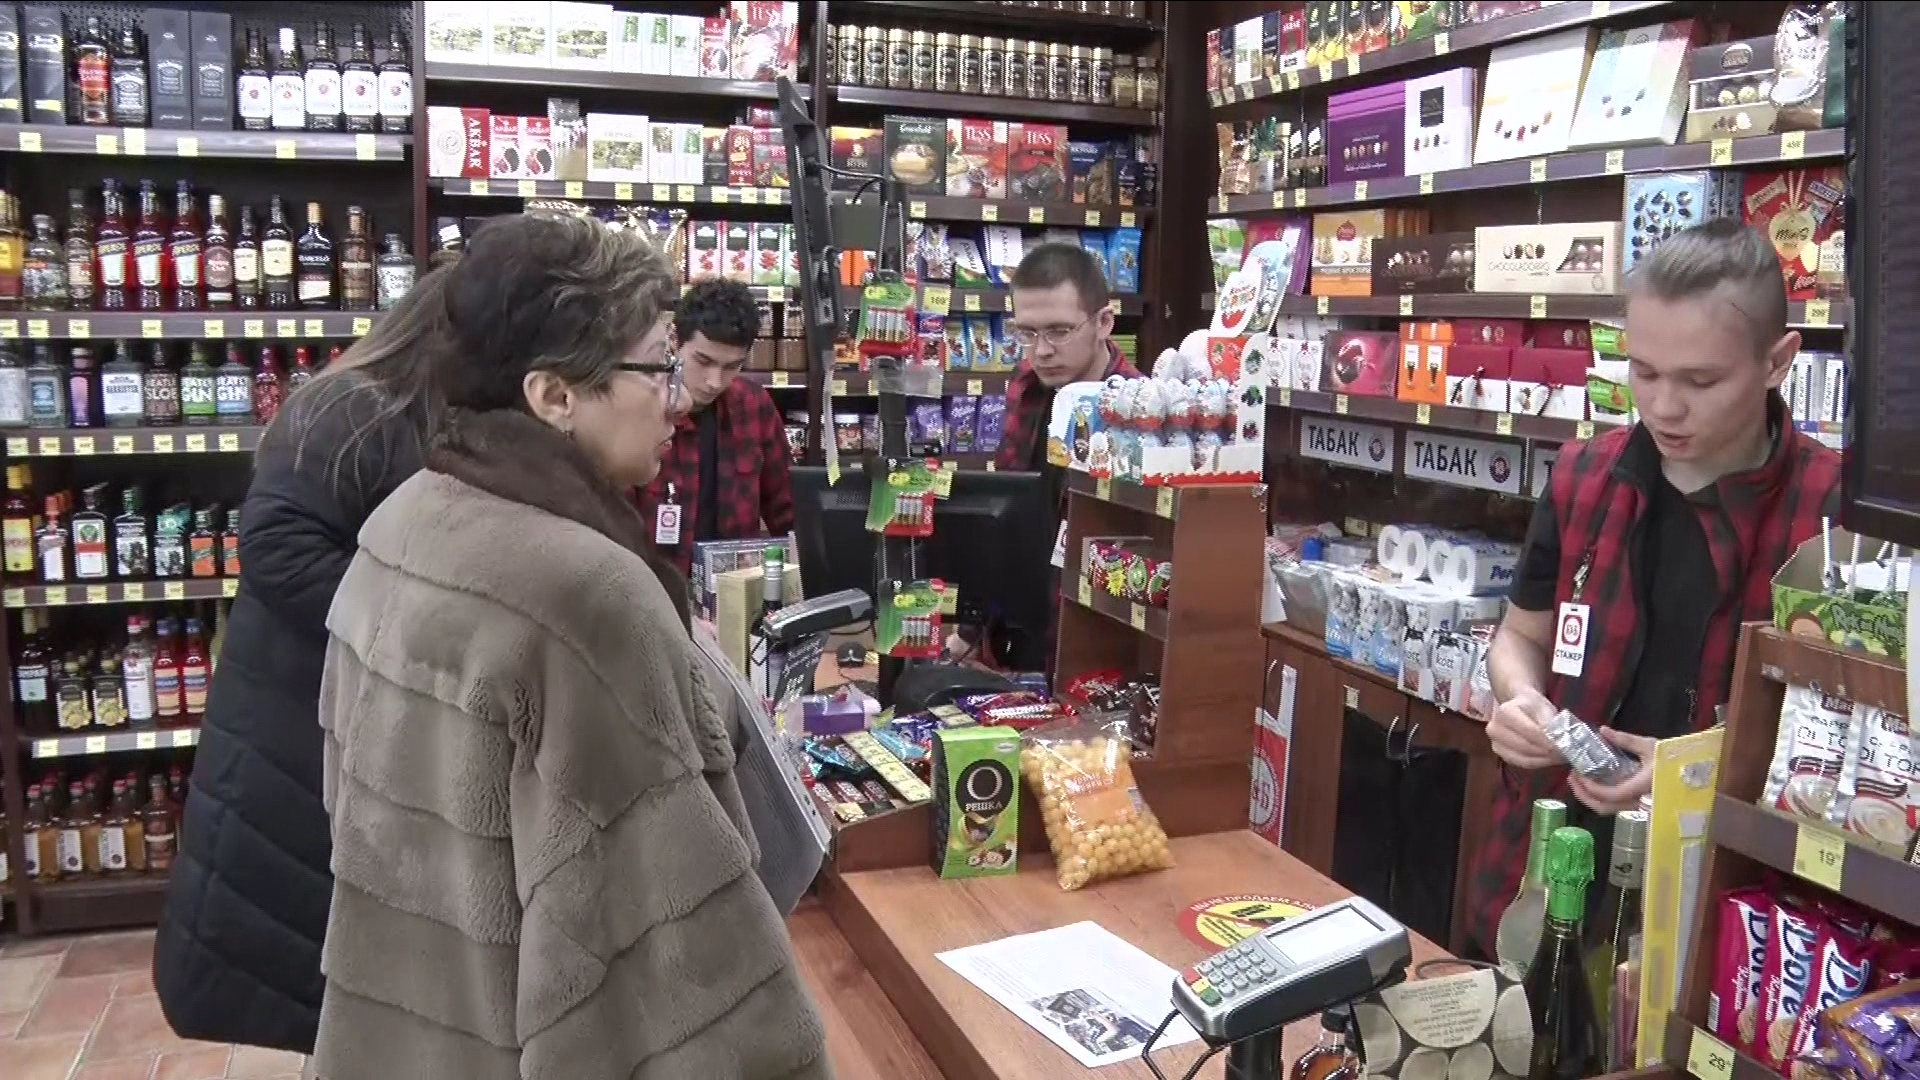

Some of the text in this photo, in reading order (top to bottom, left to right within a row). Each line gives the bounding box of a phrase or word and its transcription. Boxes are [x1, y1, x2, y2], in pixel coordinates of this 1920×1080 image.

[964, 125, 990, 142] TESS
[1026, 130, 1051, 144] TESS
[468, 117, 483, 168] AKBAR
[864, 286, 888, 300] GP
[182, 387, 213, 402] GIN
[217, 386, 250, 401] GIN
[1308, 425, 1359, 457] ТАБАК
[1413, 441, 1478, 477] ТАБАК
[888, 472, 911, 487] GP
[894, 593, 916, 608] GP
[1555, 649, 1583, 662] СТАЖЕР
[965, 800, 1003, 812] РЕШКА
[1224, 894, 1290, 905] ПРОДАЕМ
